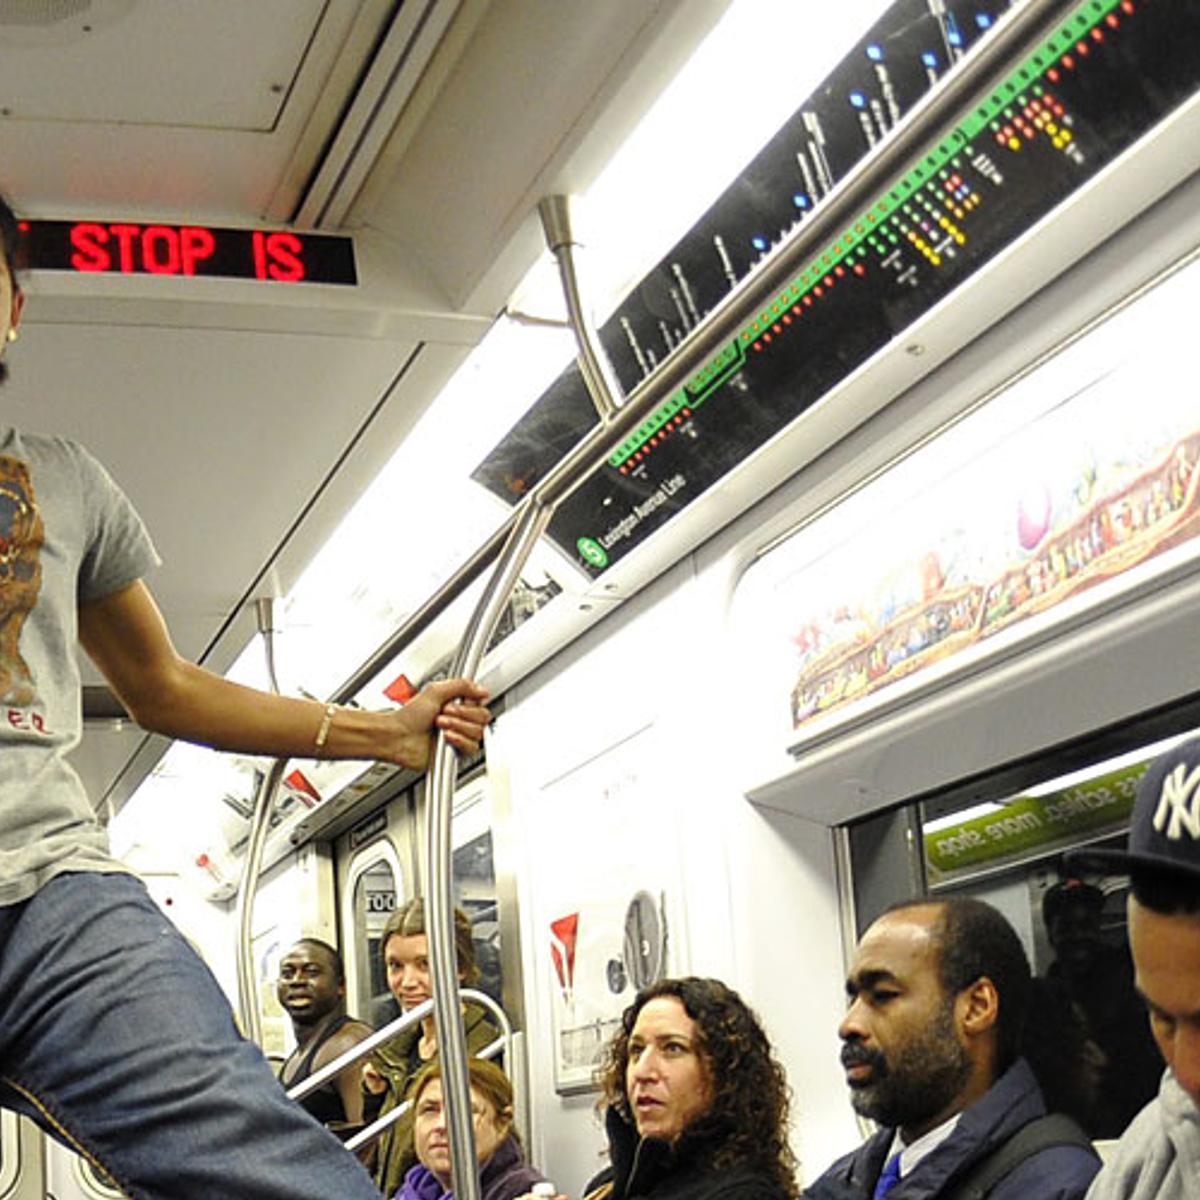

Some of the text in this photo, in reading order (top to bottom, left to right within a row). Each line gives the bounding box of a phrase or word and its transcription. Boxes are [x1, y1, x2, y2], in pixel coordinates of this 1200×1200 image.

[69, 220, 306, 283] STOP IS
[633, 490, 668, 520] Avenue
[660, 474, 687, 496] Line
